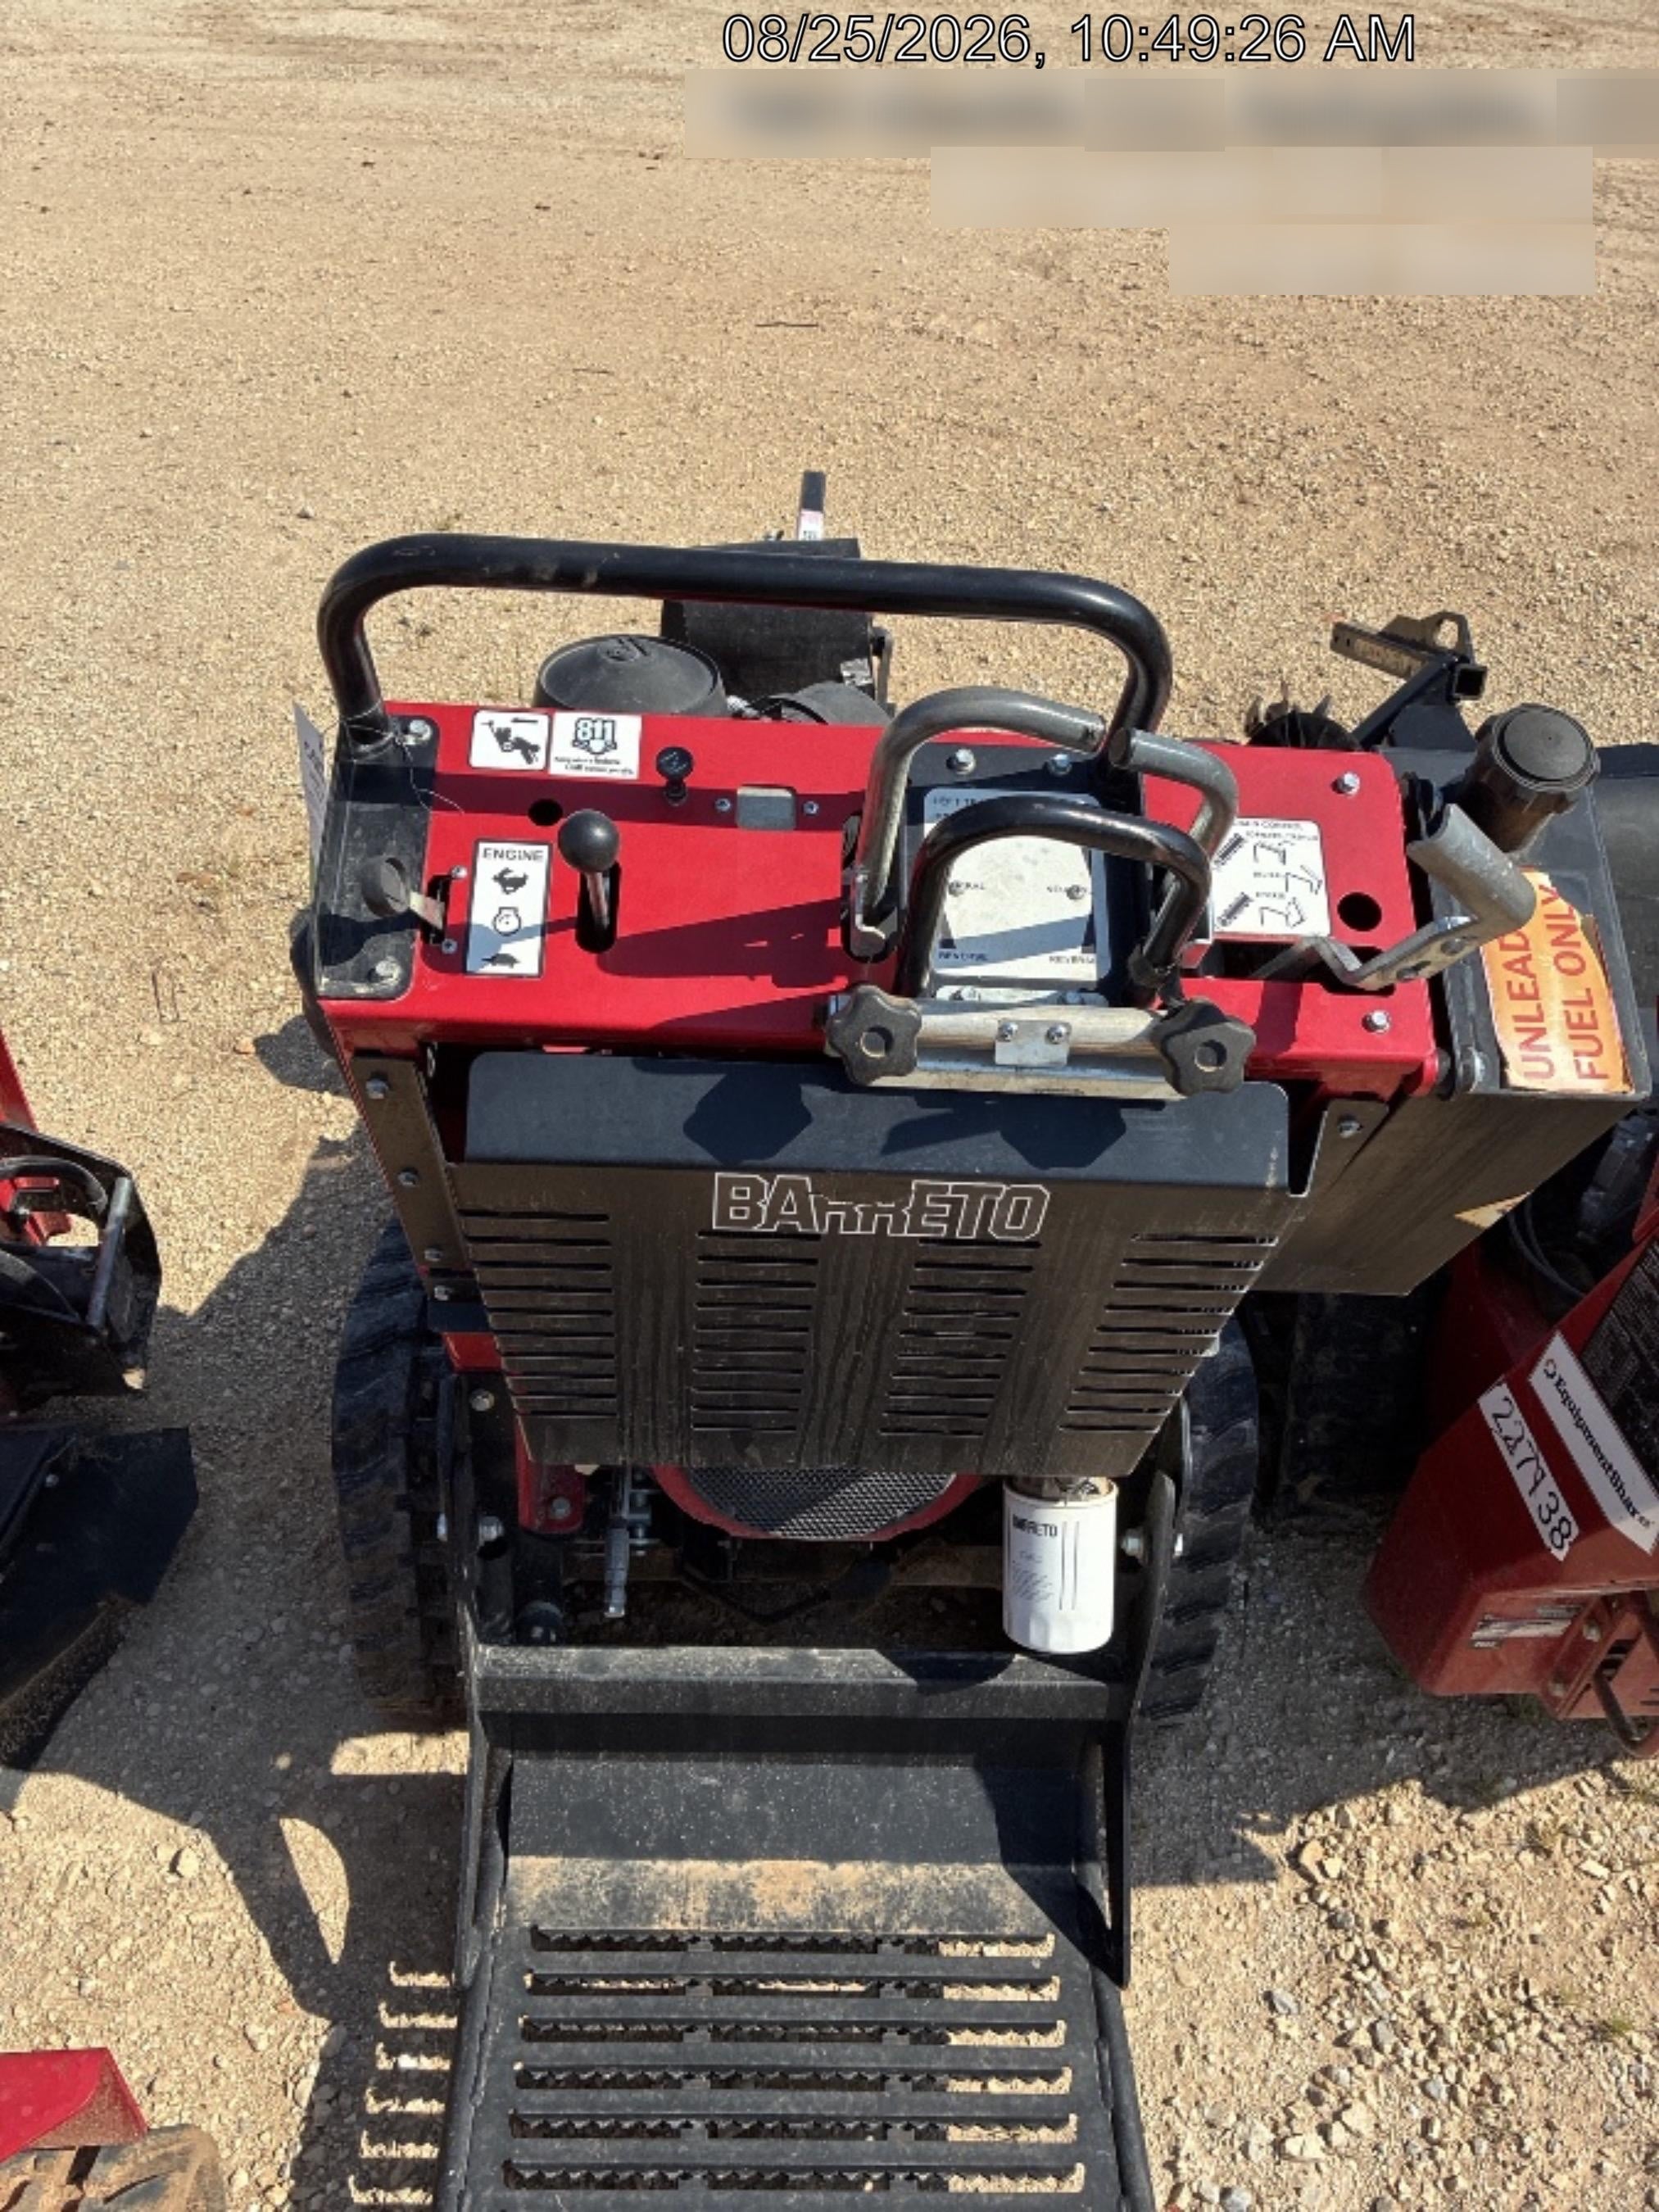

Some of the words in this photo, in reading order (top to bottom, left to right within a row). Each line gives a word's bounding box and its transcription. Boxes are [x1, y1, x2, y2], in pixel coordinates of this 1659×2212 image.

[574, 718, 615, 741] 811
[483, 847, 545, 863] ENGINE
[1539, 884, 1587, 977] ONLY
[1562, 988, 1610, 1080] FUEL
[712, 1172, 1050, 1240] BARRETO
